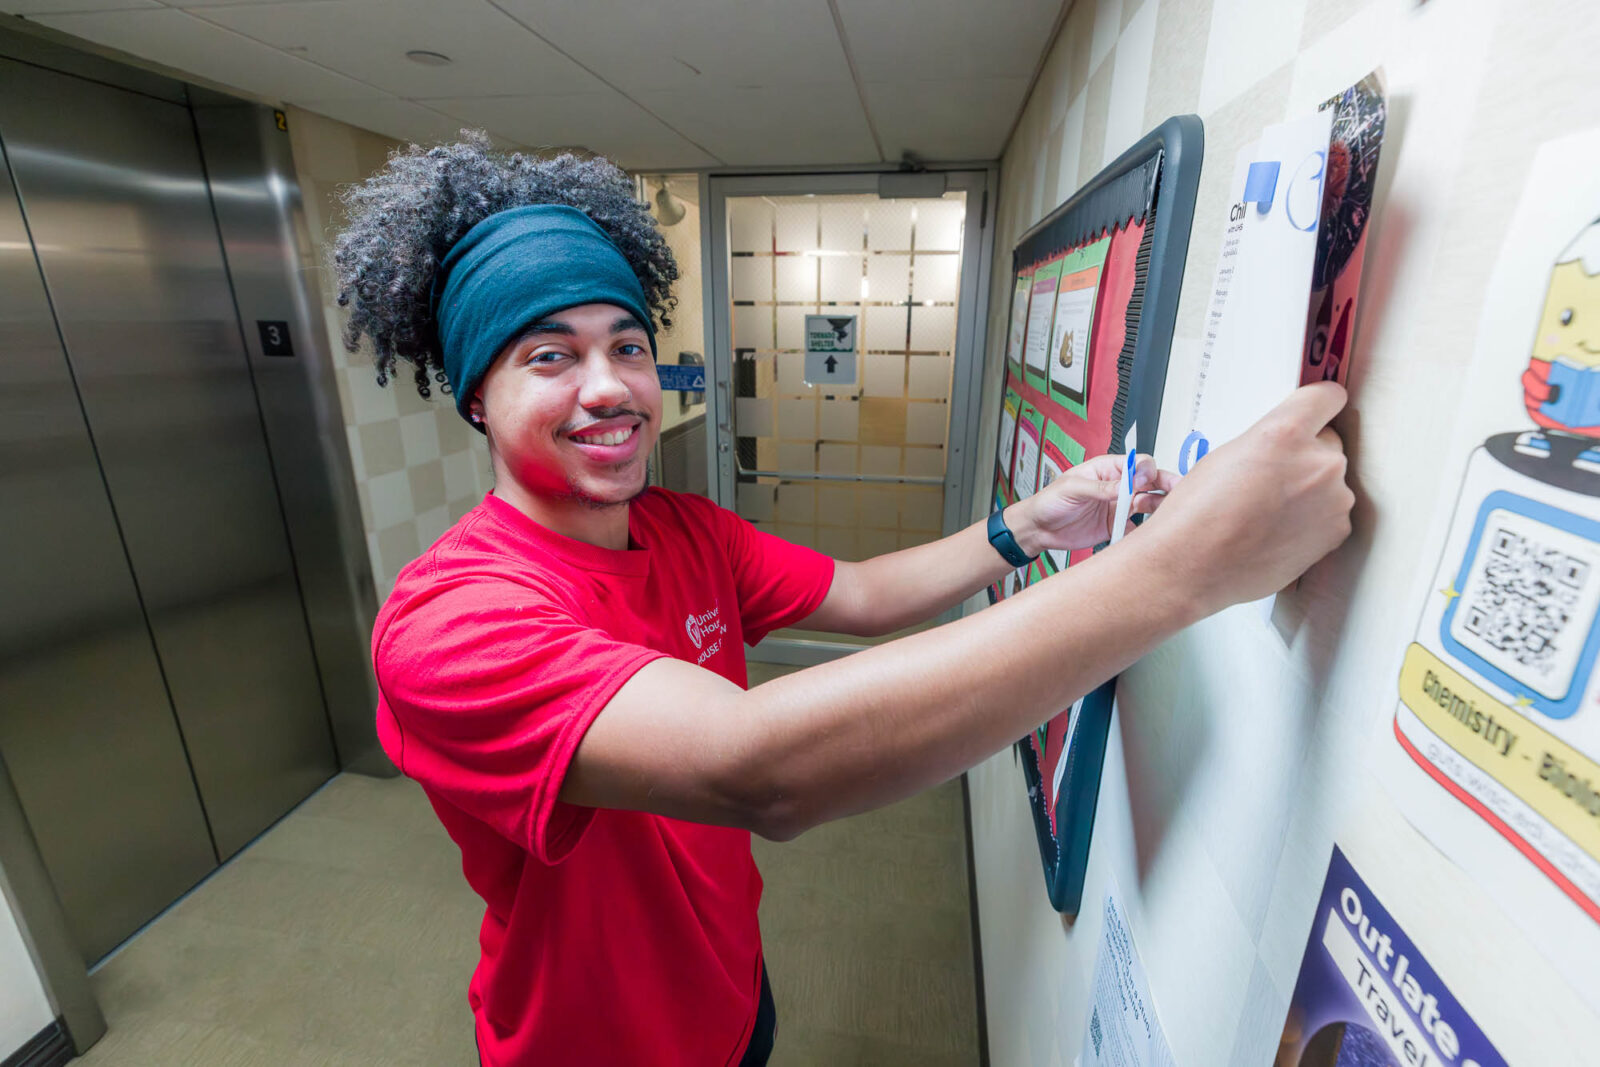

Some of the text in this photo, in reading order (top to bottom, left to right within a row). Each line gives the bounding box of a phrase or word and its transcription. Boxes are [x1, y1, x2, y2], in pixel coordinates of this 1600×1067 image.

[268, 325, 281, 346] 3
[1423, 669, 1518, 758] Chemistry
[1341, 887, 1460, 1061] Out late
